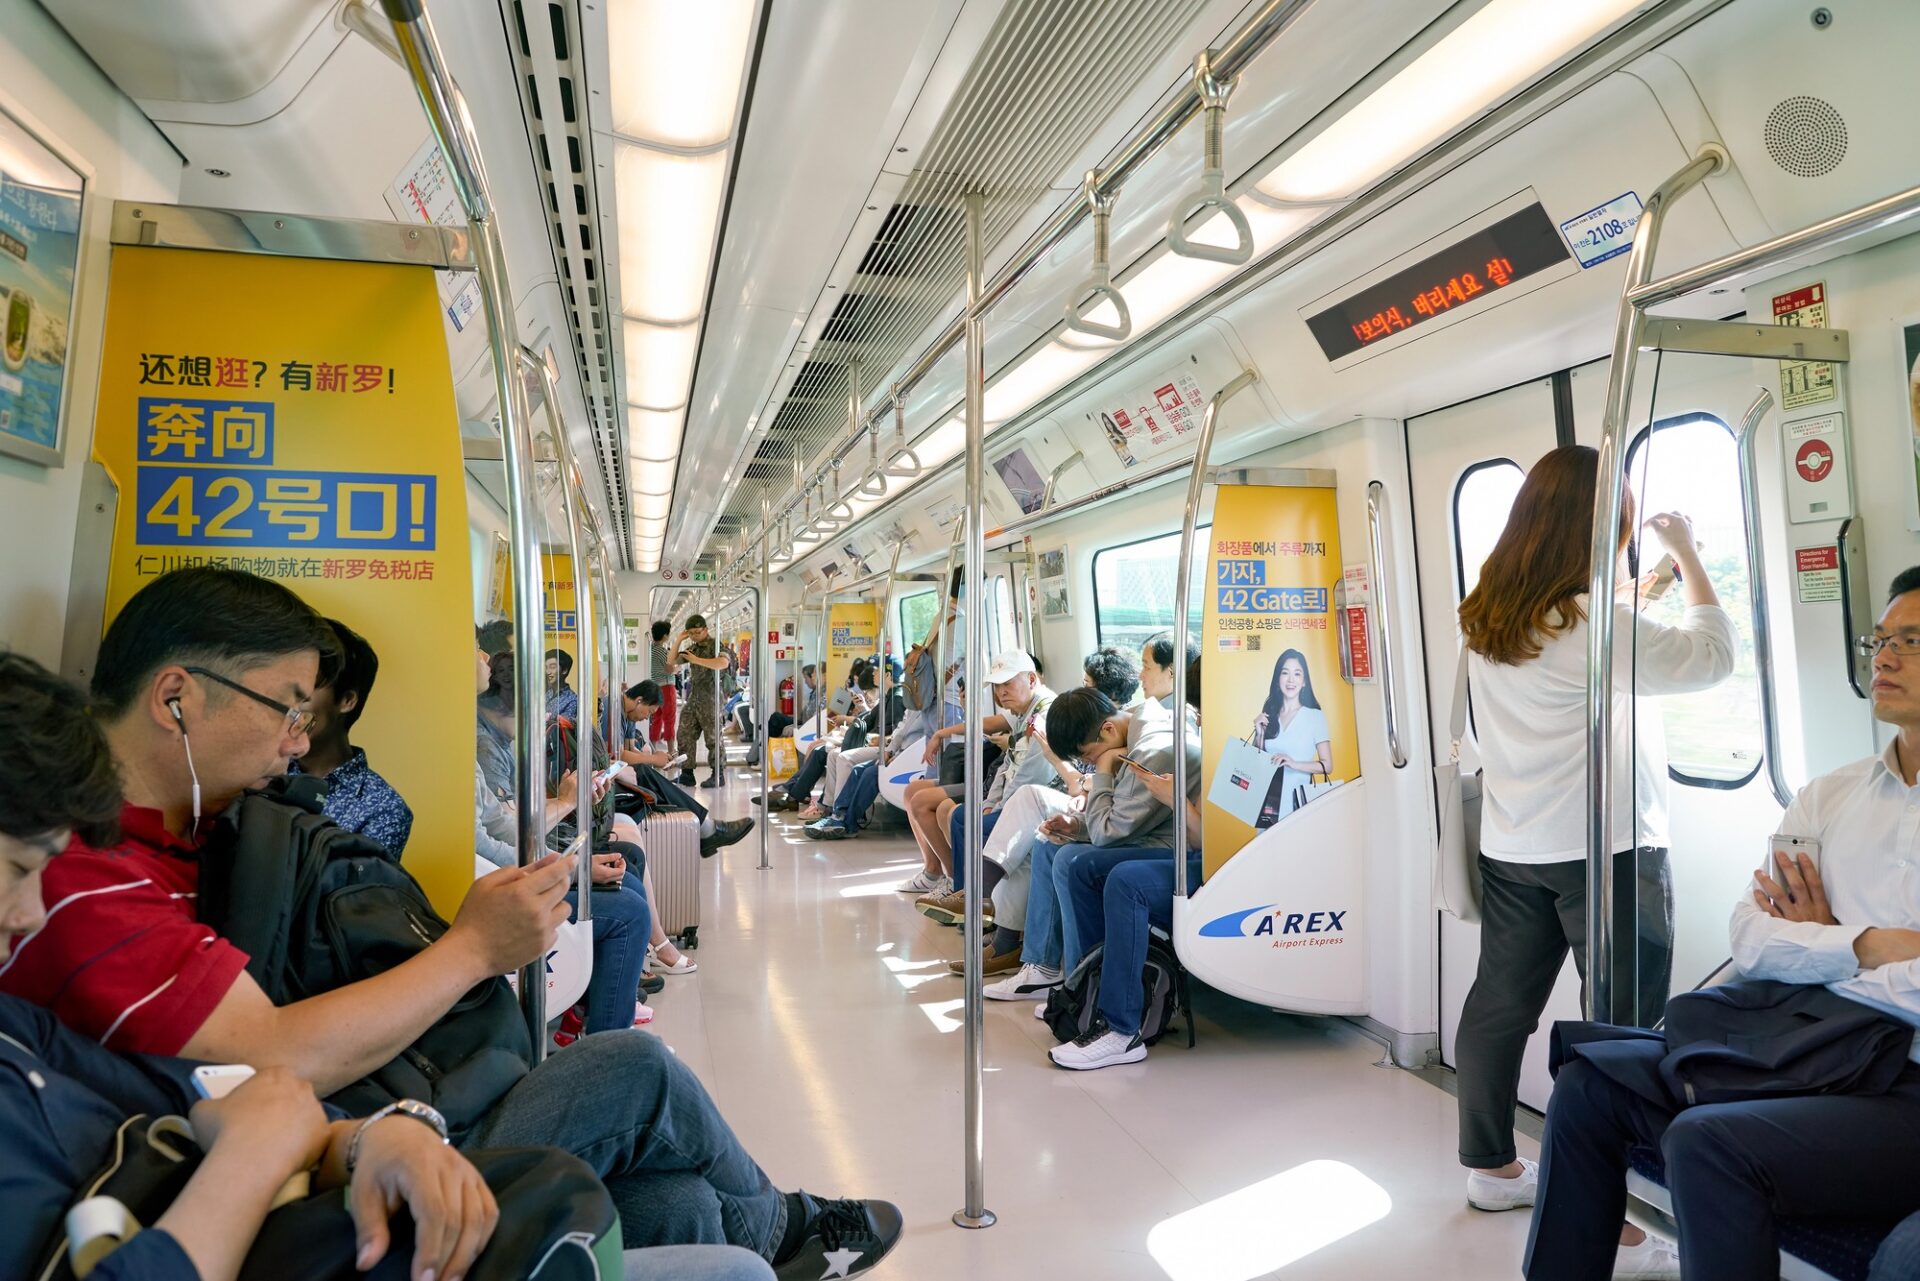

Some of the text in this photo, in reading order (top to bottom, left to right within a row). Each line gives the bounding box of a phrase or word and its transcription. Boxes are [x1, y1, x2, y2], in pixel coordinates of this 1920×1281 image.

[1352, 306, 1412, 346] 보의식,
[1411, 272, 1484, 316] 버리세요
[139, 353, 394, 394] 还想逛? 有新罗!
[147, 403, 267, 459] 奔向
[146, 473, 425, 543] 42号口!
[1217, 541, 1326, 556] 화장품에서 주류까지
[135, 552, 434, 581] 仁川机场购物就在新罗免税店
[1219, 561, 1261, 584] 가자,
[1219, 618, 1327, 630] 인천공항 쇼핑은 신라면세점
[1272, 937, 1344, 949] Airport Express
